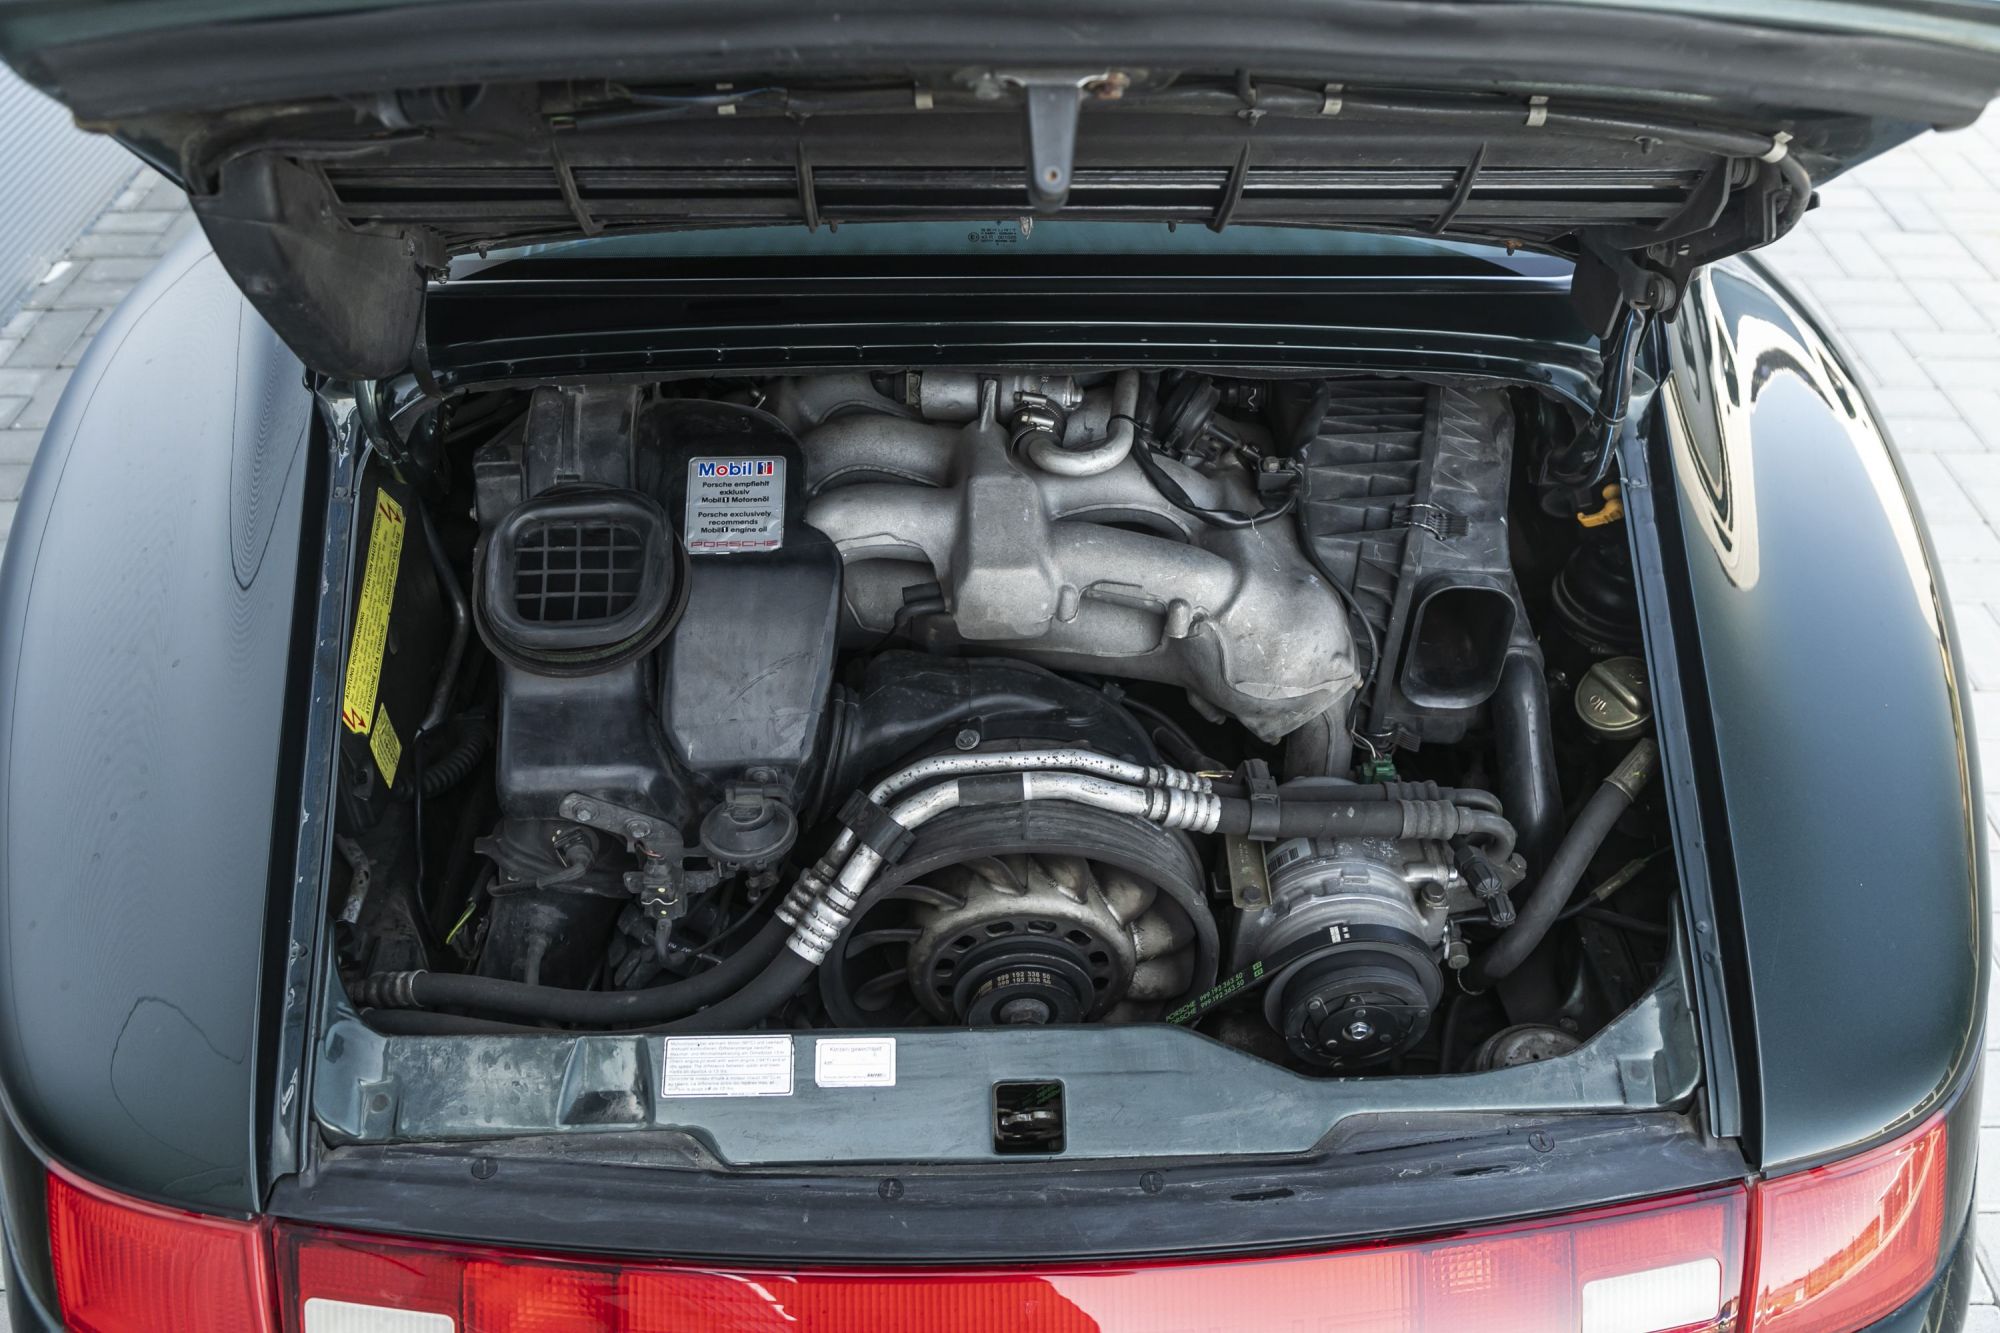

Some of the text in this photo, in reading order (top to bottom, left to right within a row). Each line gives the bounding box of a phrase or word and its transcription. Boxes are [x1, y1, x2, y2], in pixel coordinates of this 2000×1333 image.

[699, 461, 752, 477] Mobil
[734, 480, 770, 488] empfiehlt
[1590, 695, 1607, 715] OIL
[1166, 1000, 1196, 1023] PORSCHE
